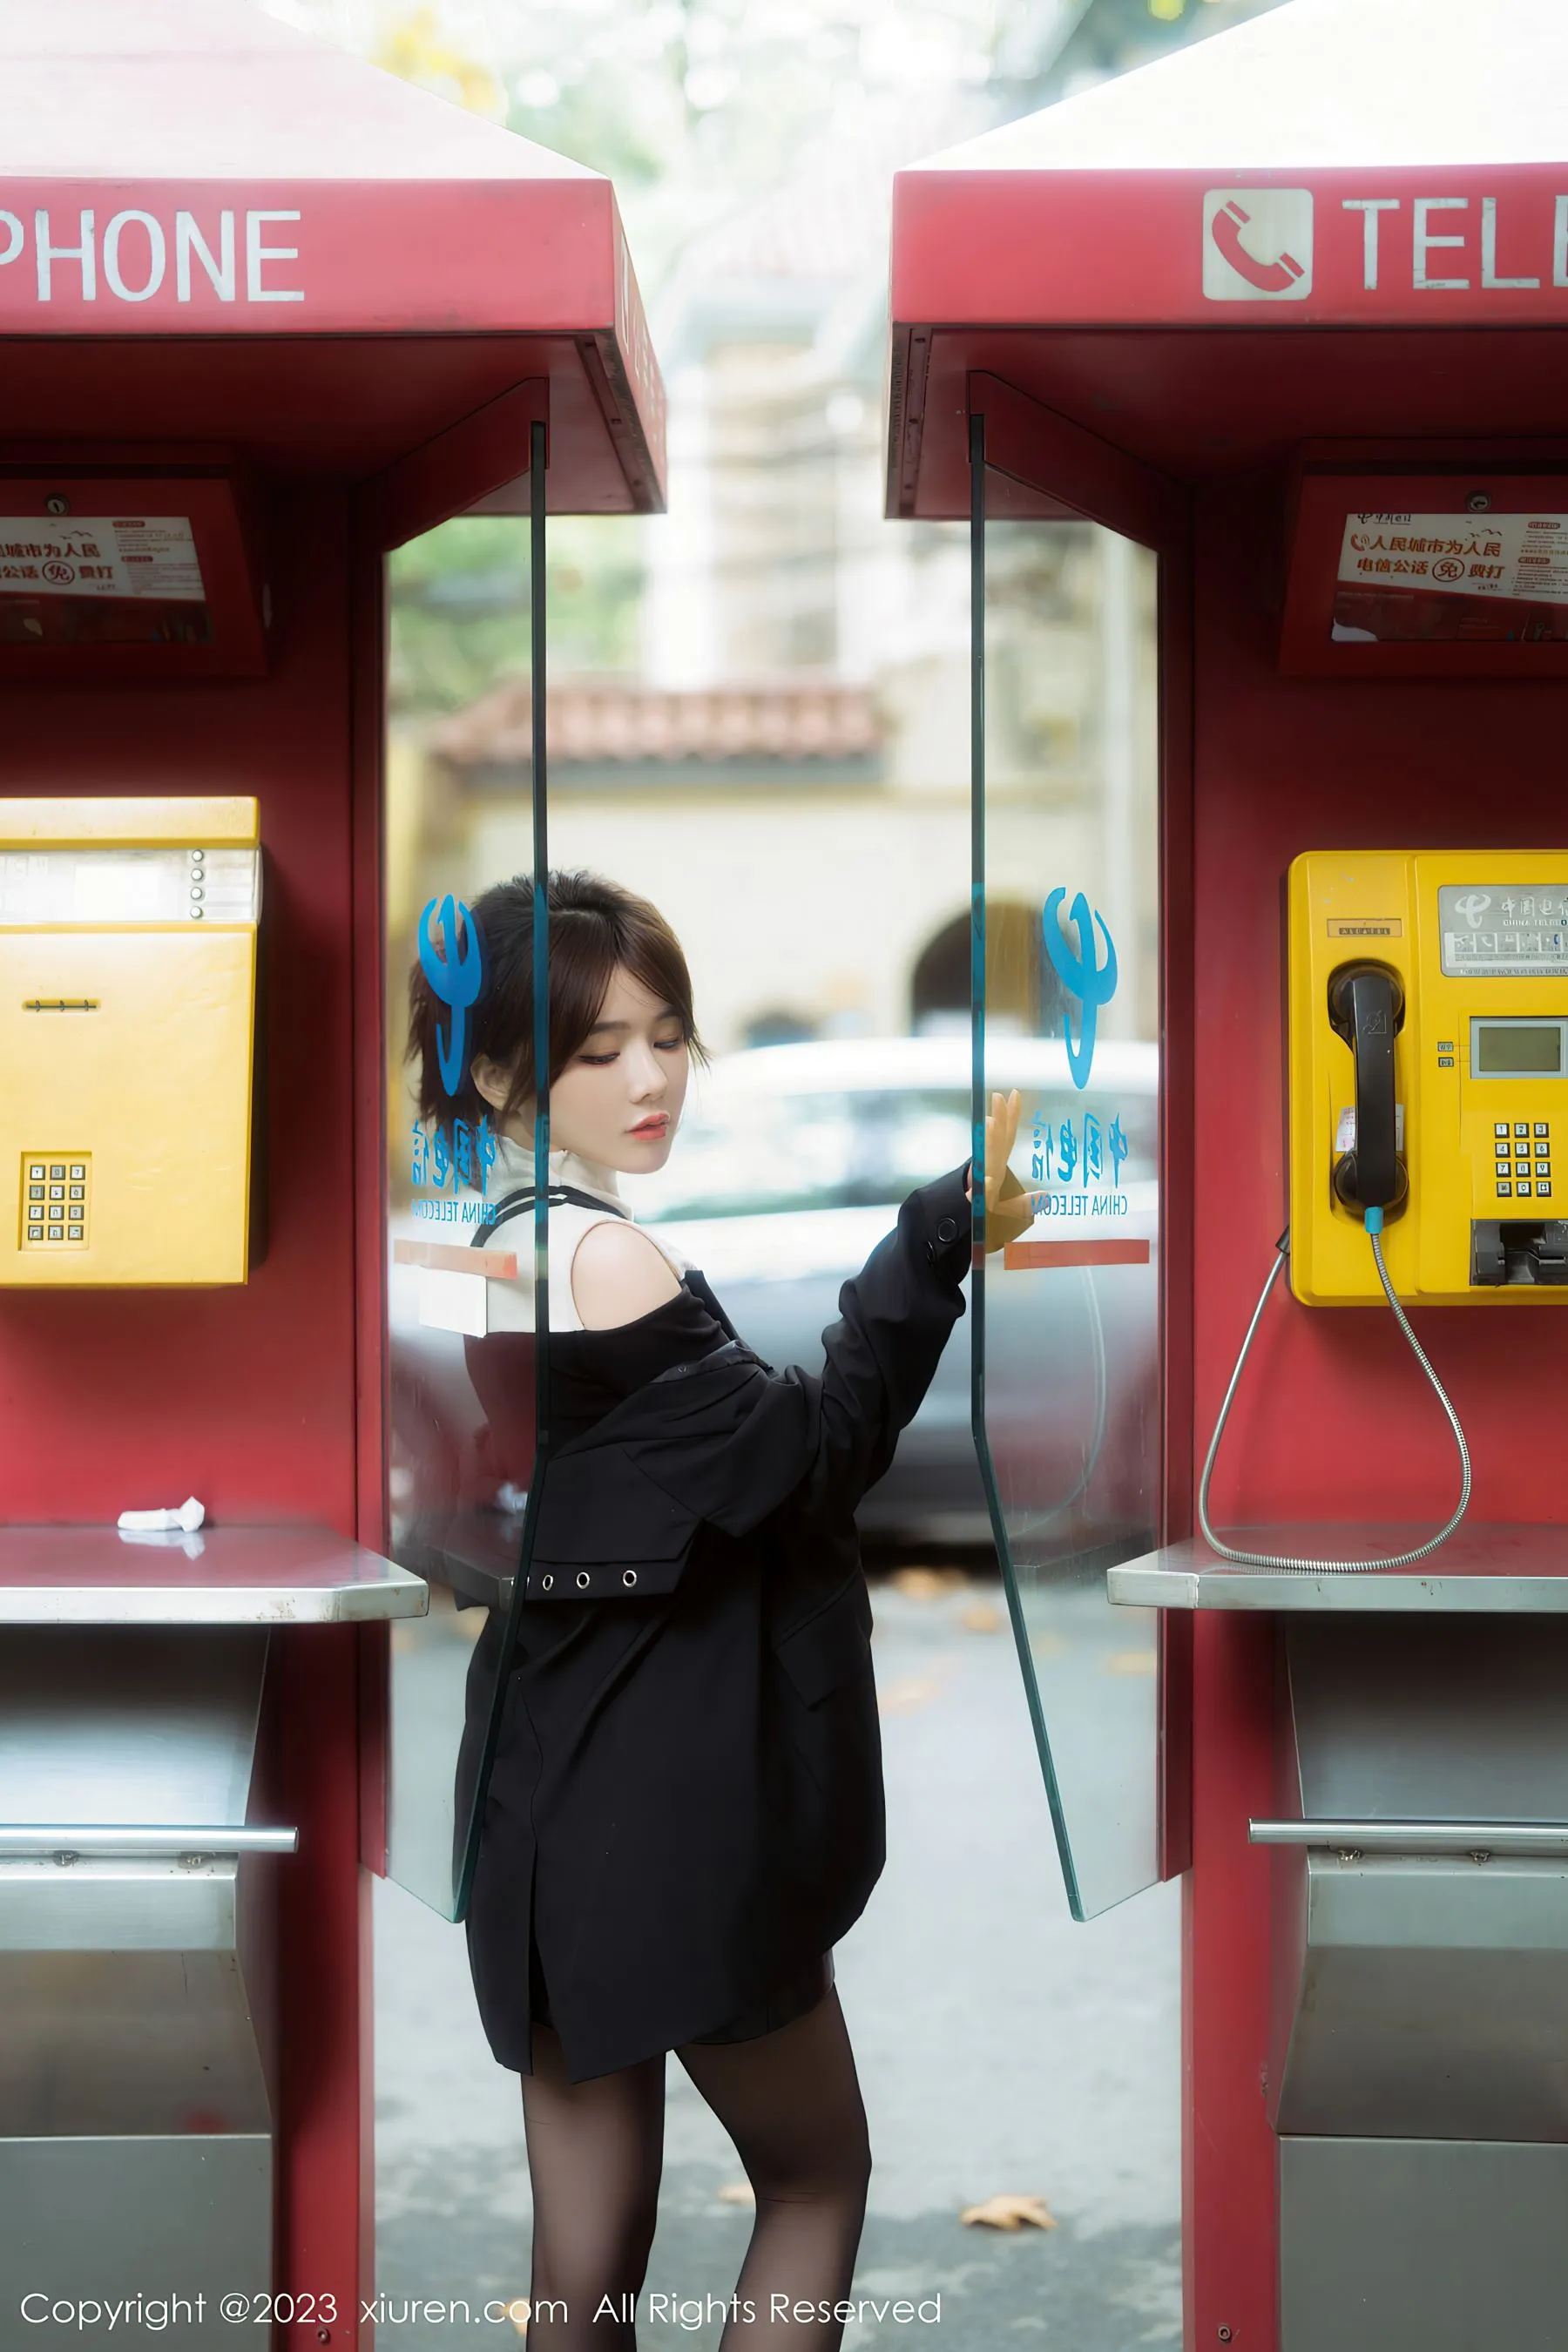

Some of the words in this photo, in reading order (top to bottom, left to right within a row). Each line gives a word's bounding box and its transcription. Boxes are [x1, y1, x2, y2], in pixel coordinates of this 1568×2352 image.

[1342, 194, 1568, 290] TEL
[1369, 535, 1503, 558] 人民城市为人民
